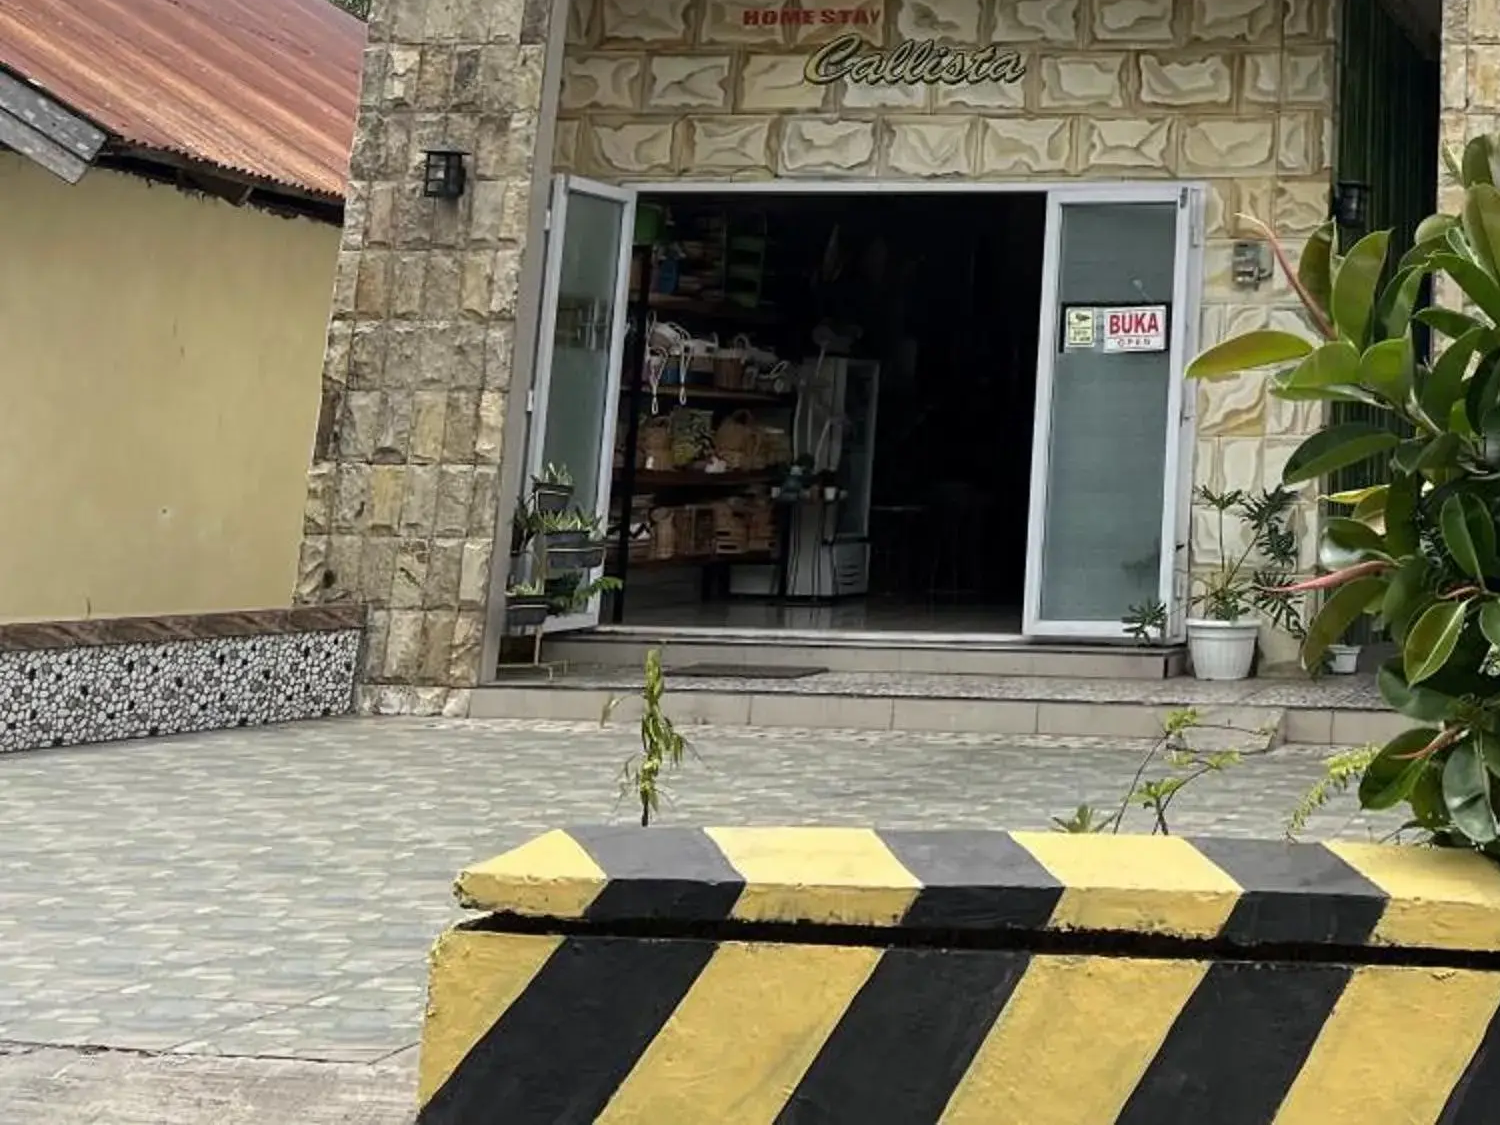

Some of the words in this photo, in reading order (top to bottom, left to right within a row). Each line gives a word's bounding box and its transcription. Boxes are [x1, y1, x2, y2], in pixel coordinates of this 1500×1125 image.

[803, 32, 1026, 87] Callista
[1109, 312, 1159, 335] BUKA
[1117, 337, 1151, 348] OPEN
